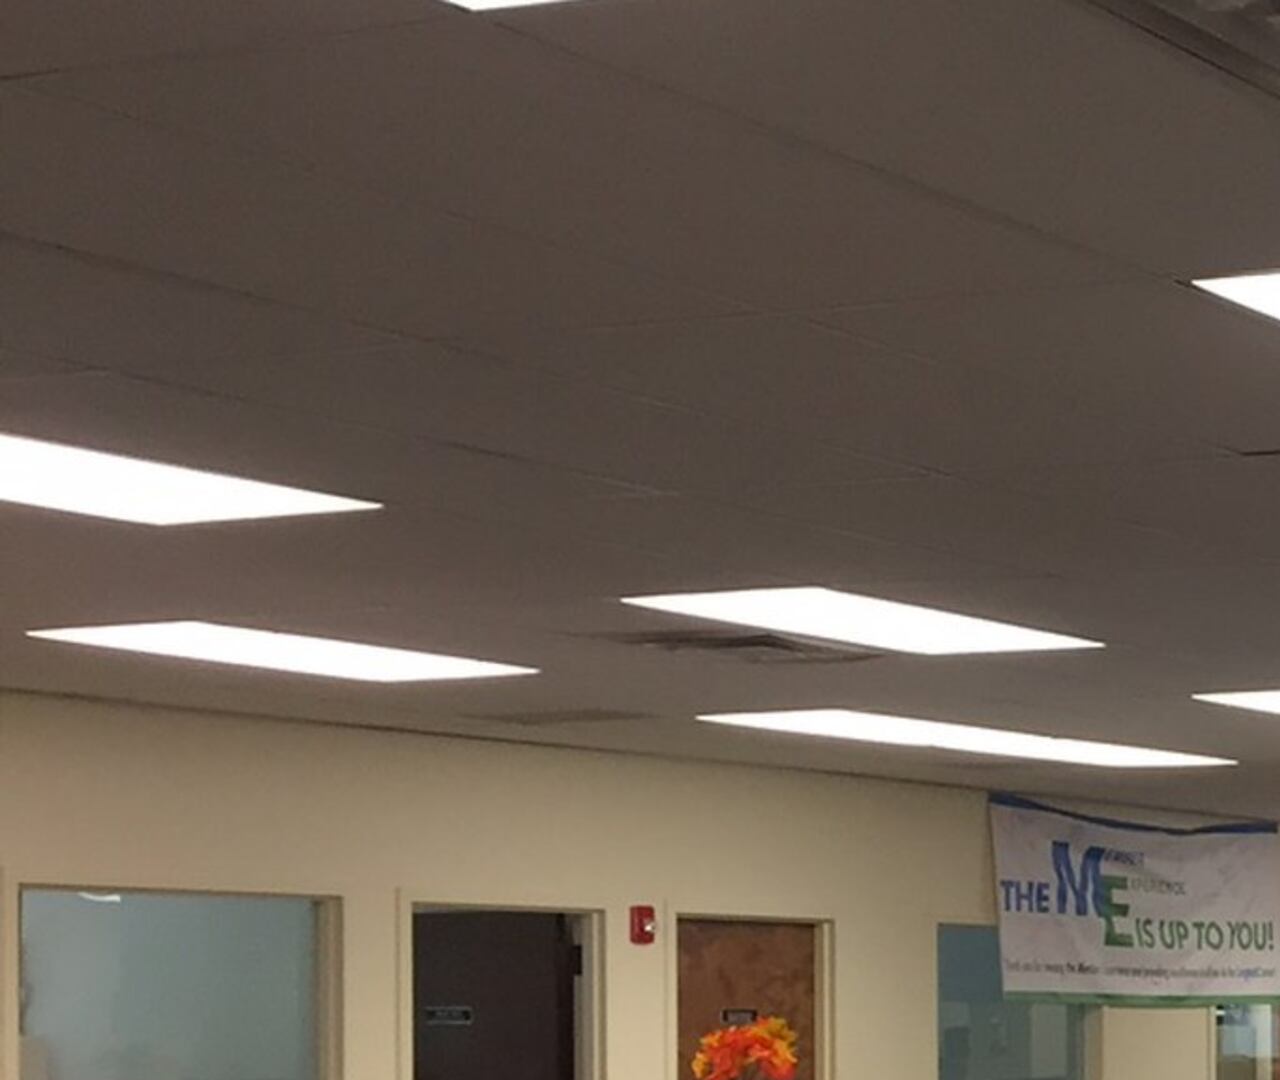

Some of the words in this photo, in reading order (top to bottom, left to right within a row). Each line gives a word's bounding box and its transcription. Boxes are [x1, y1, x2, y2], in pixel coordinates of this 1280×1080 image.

[1000, 879, 1050, 914] THE
[1135, 917, 1156, 948] IS
[1158, 919, 1190, 949] UP
[1192, 920, 1224, 950] TO
[1226, 921, 1275, 951] YOU!
